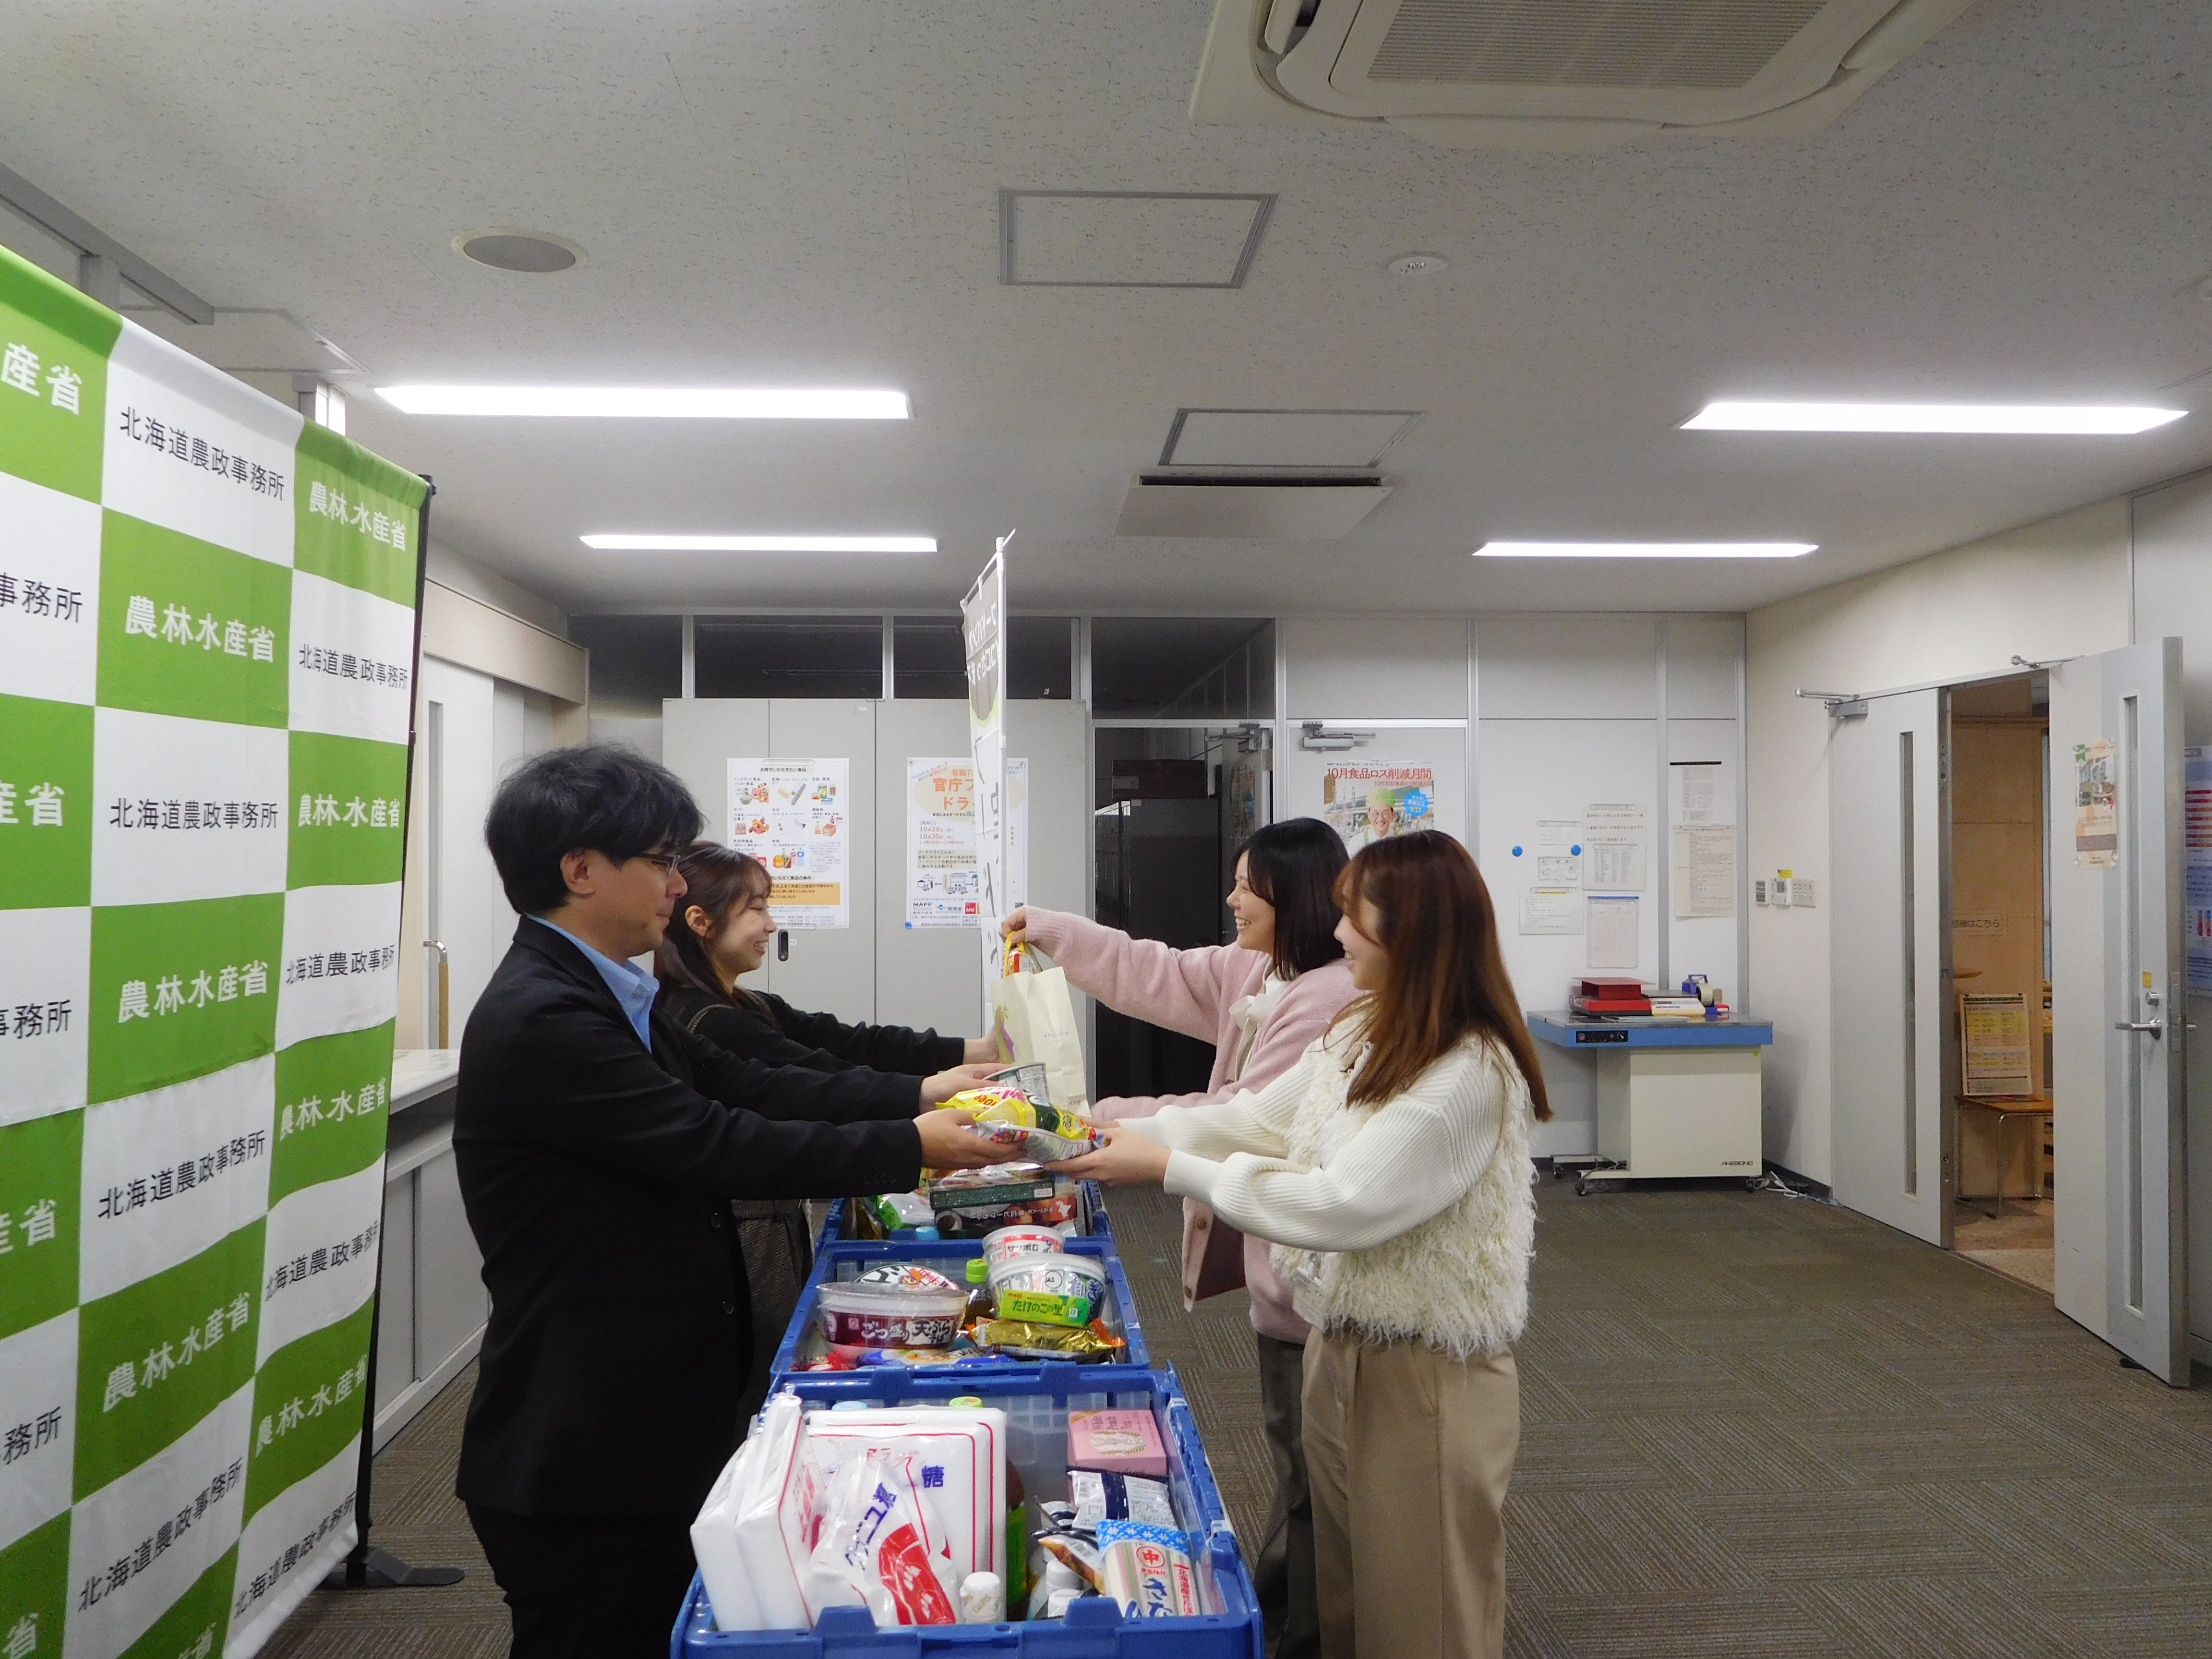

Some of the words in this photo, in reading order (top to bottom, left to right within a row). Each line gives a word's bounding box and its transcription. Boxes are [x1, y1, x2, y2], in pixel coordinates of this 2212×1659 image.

[1, 341, 83, 415] 産省
[120, 406, 285, 501] 北海道農政事務所
[309, 481, 407, 552] 農林水産省
[125, 595, 276, 663] 農林水産省
[299, 644, 408, 691] 北海道農政事務所
[943, 796, 974, 810] ドラ
[1327, 768, 1431, 780] 10月食品ロス削減月間
[109, 798, 279, 830] 北海道農政事務所
[298, 793, 401, 829] 農林水産省
[118, 961, 269, 1023] 農林水産省
[97, 1129, 266, 1220] 北海道農政事務所
[1012, 1299, 1063, 1316] たけのこの里
[102, 1291, 250, 1413] 農林水産省
[1, 1406, 62, 1466] 務所
[255, 1354, 368, 1459] 農林水産省
[78, 1456, 243, 1613] 北海道農政事務所
[233, 1491, 356, 1620] 北海道農政事務所
